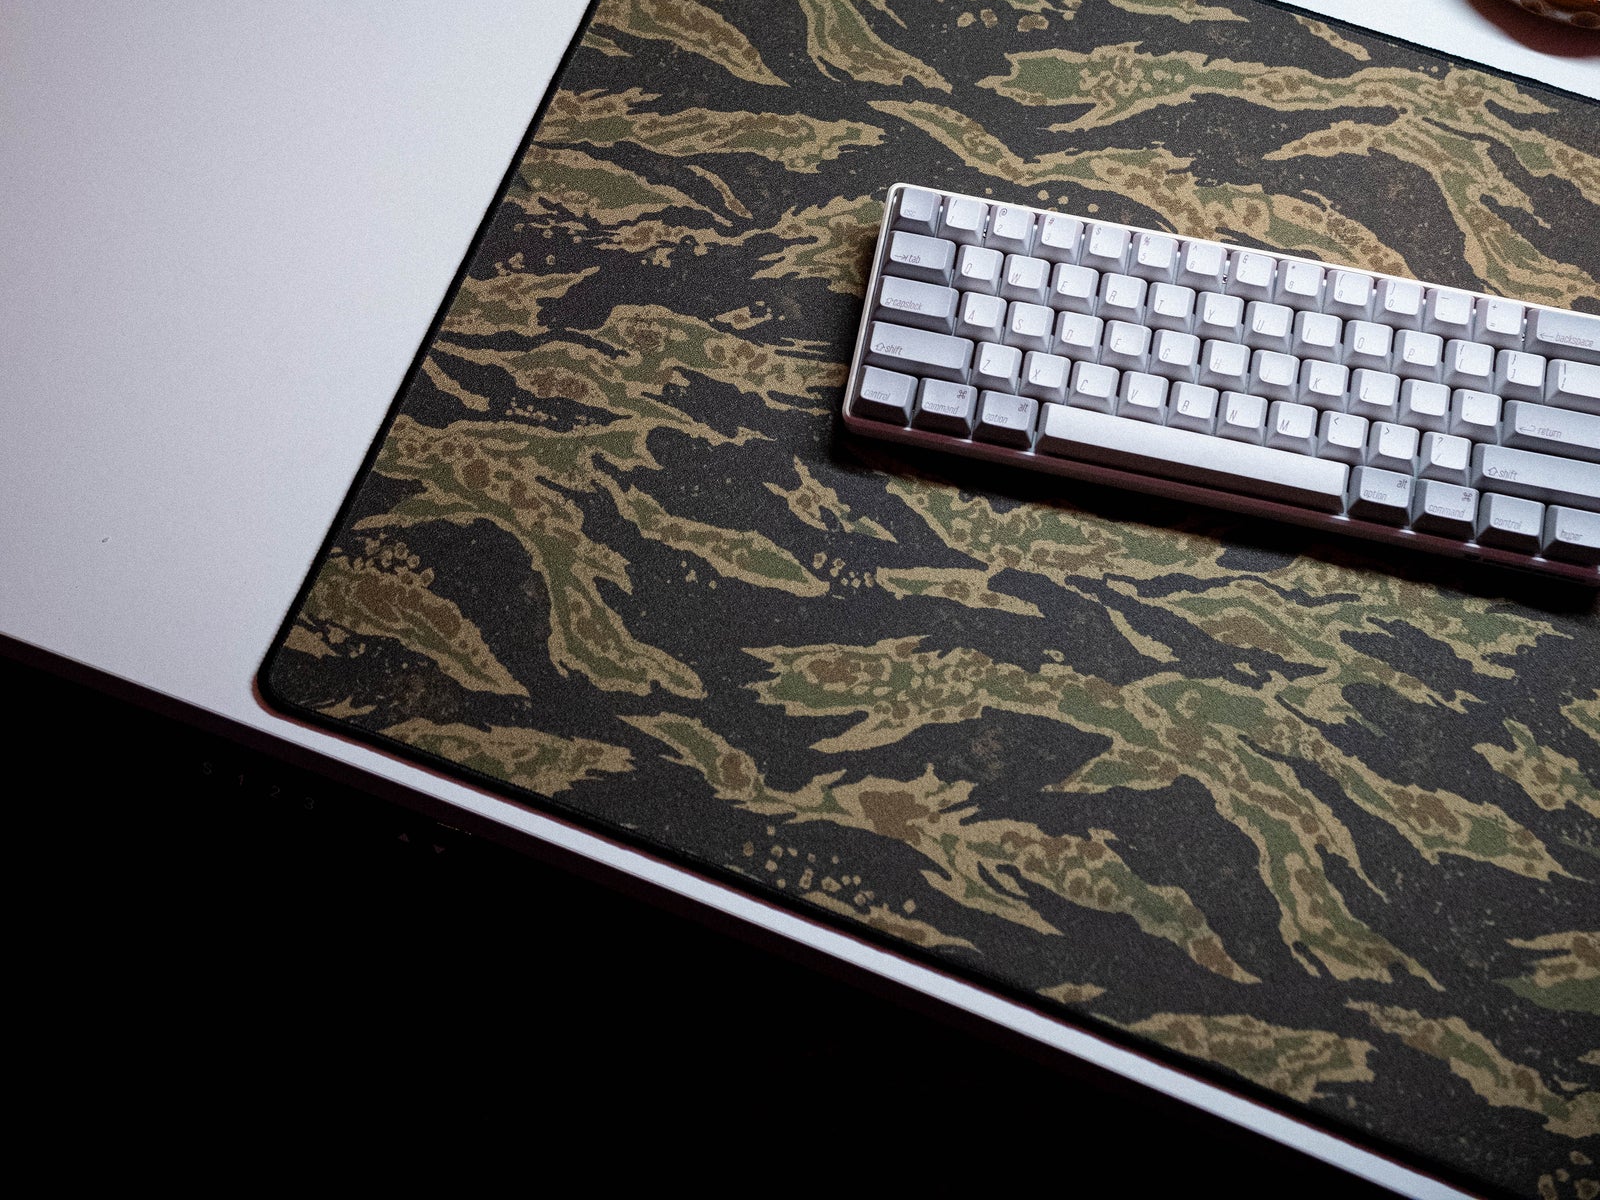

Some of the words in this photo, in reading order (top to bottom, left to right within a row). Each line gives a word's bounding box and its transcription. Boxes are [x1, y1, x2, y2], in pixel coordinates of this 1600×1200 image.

[908, 254, 921, 264] tab
[964, 263, 973, 274] Q
[1012, 273, 1021, 284] W
[1060, 280, 1069, 293] E
[1108, 290, 1117, 302] R
[1157, 299, 1165, 312] T
[1207, 308, 1215, 320] Y
[1256, 319, 1265, 332] U
[1407, 348, 1416, 360] P
[1140, 253, 1147, 262] 5
[1189, 261, 1195, 270] 6
[1288, 280, 1294, 290] 8
[1337, 290, 1344, 300] 9
[1555, 332, 1595, 348] backspace
[886, 344, 904, 355] shift
[982, 359, 991, 372] Z
[1031, 368, 1041, 381] X
[1080, 379, 1089, 392] C
[1130, 389, 1139, 401] V
[1182, 400, 1191, 412] B
[1229, 409, 1238, 422] N
[1280, 419, 1290, 432] M
[1498, 469, 1519, 481] shift
[893, 299, 922, 311] capslock
[968, 310, 976, 322] A
[1015, 318, 1024, 330] S
[1066, 329, 1074, 341] D
[1113, 337, 1122, 349] F
[1162, 347, 1171, 359] G
[1213, 358, 1223, 370] H
[1312, 377, 1321, 390] K
[1362, 387, 1369, 400] L
[1537, 427, 1562, 439] return
[1018, 402, 1029, 413] alt
[864, 389, 891, 401] control
[924, 401, 960, 415] command
[985, 413, 1009, 425] option
[1363, 489, 1388, 502] option
[1428, 505, 1465, 519] command
[1494, 517, 1523, 531] control
[1396, 479, 1408, 490] alt
